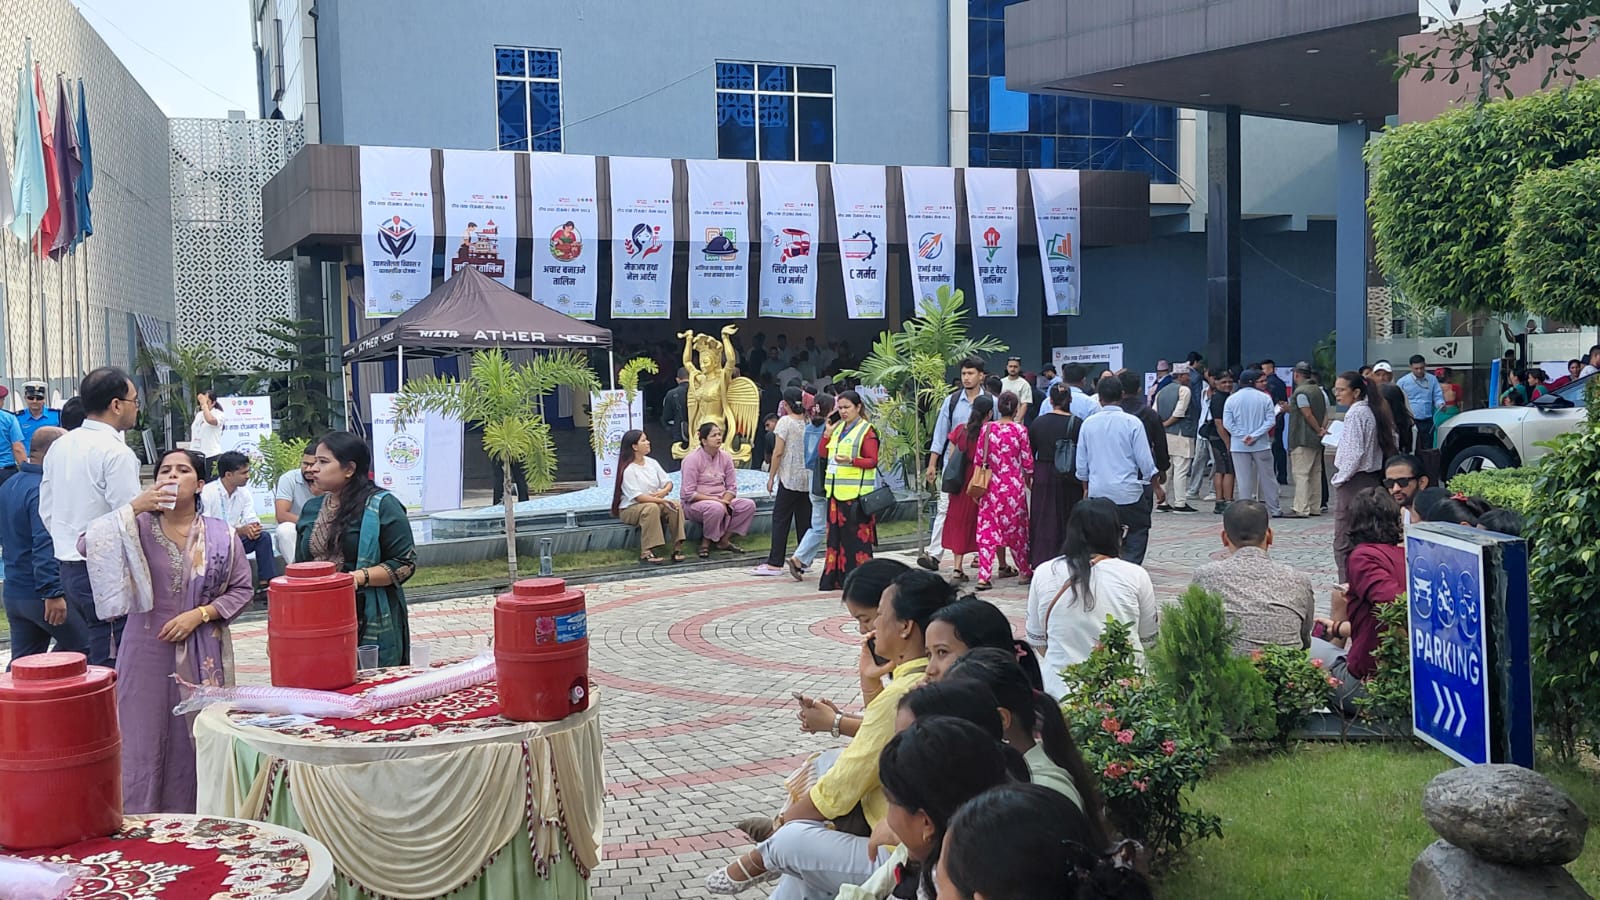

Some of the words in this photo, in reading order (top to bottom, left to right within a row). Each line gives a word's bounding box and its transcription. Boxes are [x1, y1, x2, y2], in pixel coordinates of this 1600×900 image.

[478, 263, 503, 273] तालिम
[543, 266, 560, 274] अचार
[562, 264, 586, 274] बनाउने
[772, 265, 787, 273] सिटी
[788, 265, 808, 274] सफारी
[995, 265, 1007, 274] वेटर
[627, 272, 638, 280] नेल
[856, 266, 877, 280] मर्मत
[553, 276, 575, 285] तालिम
[778, 276, 786, 284] EV
[788, 275, 804, 284] मर्मत
[982, 275, 1002, 284] तालिम
[474, 330, 546, 342] ATHER
[358, 337, 379, 352] ATHER
[1415, 628, 1480, 686] PARKING
